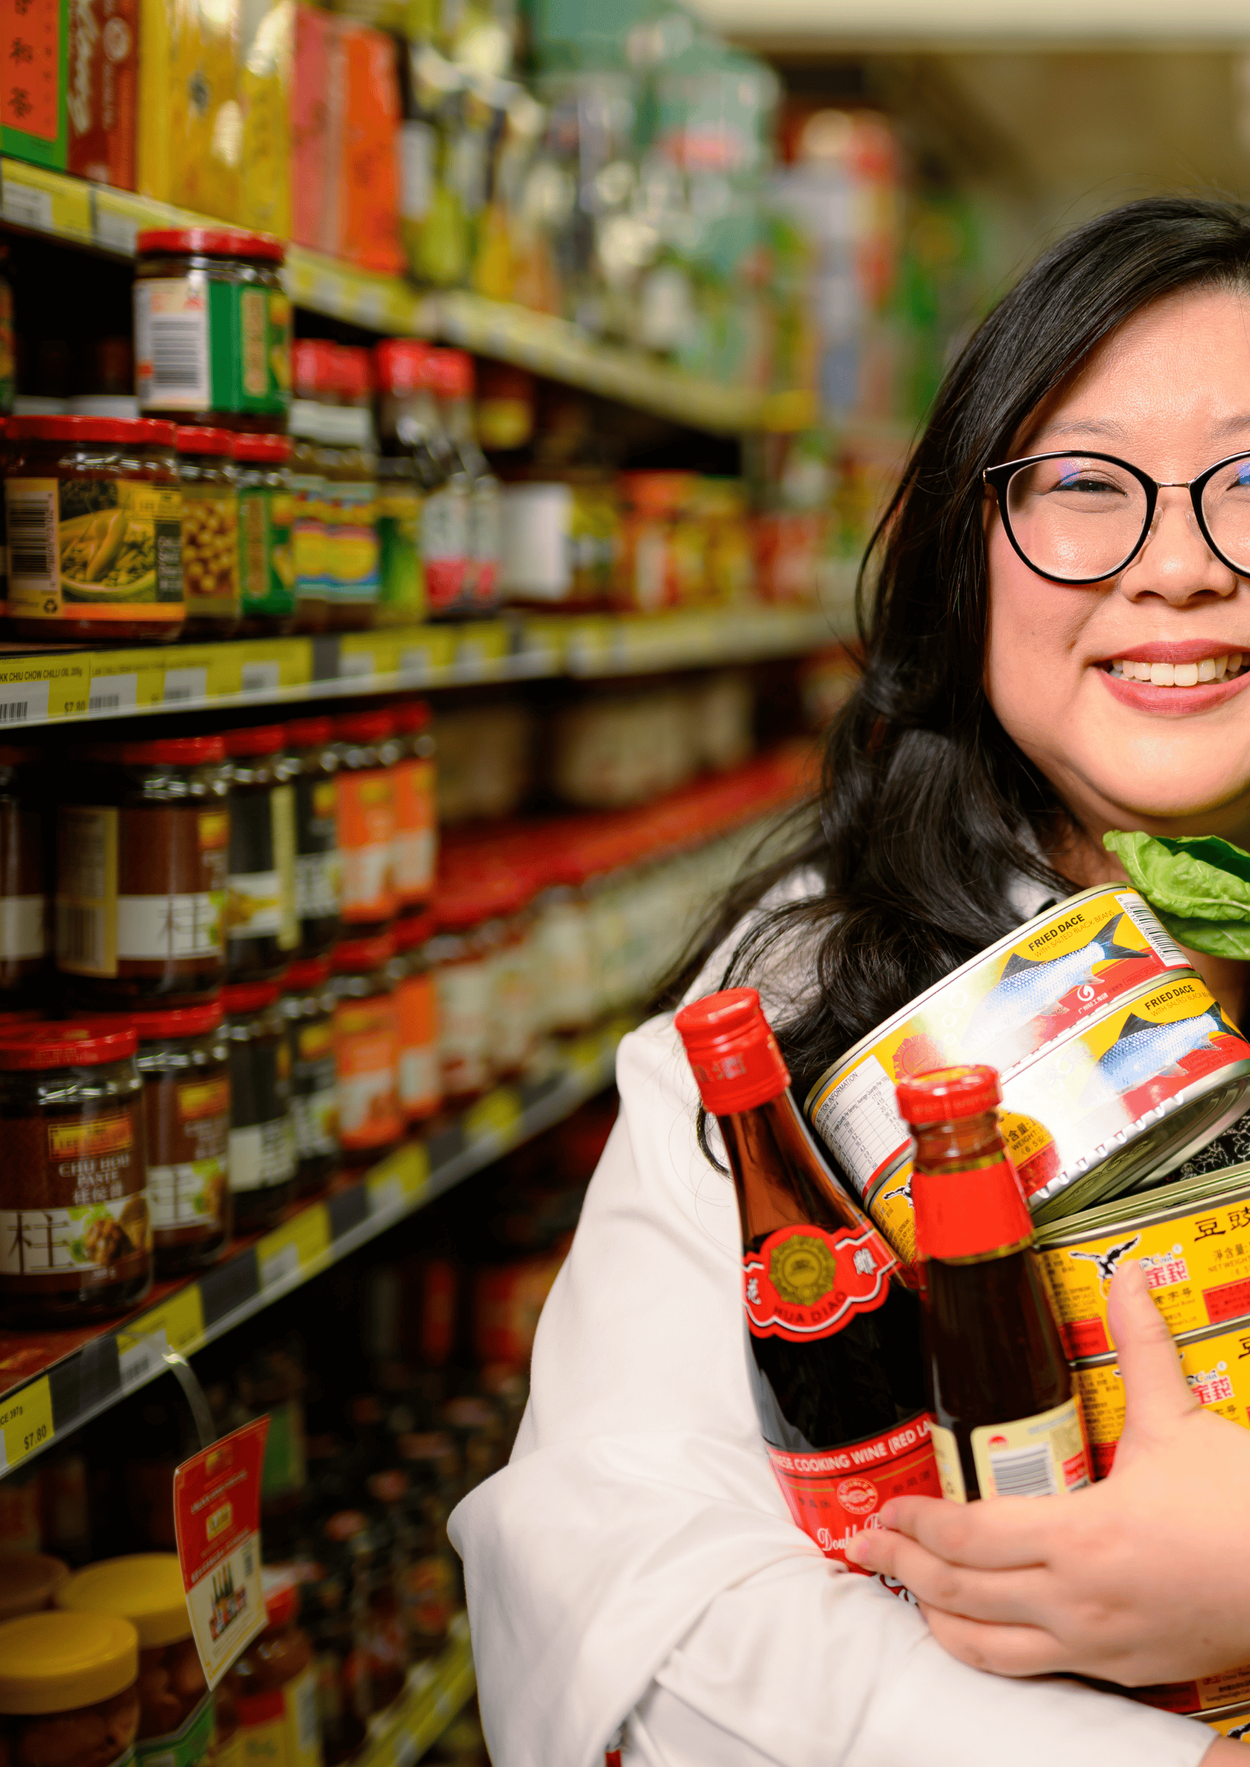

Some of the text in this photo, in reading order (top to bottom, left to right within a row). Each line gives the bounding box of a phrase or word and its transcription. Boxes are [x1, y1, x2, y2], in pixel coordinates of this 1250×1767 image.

[9, 671, 23, 681] CHIU
[25, 669, 42, 680] CHOW
[1028, 914, 1085, 952] FRIED DACE
[1034, 910, 1115, 958] WITH SALTED BLACK BEANS
[1144, 992, 1174, 1011] FRIED
[1173, 984, 1195, 997] DACE
[1150, 1005, 1168, 1017] WITH
[828, 1072, 858, 1104] INFORMATION
[59, 1161, 95, 1177] CHU
[77, 1171, 119, 1187] PASTE
[8, 1210, 75, 1275] 柱
[774, 1291, 847, 1323] HUA DIAO
[24, 1425, 47, 1450] $7.80
[795, 1454, 851, 1472] COOKING
[850, 1442, 888, 1465] WINE
[888, 1430, 916, 1455] (RED
